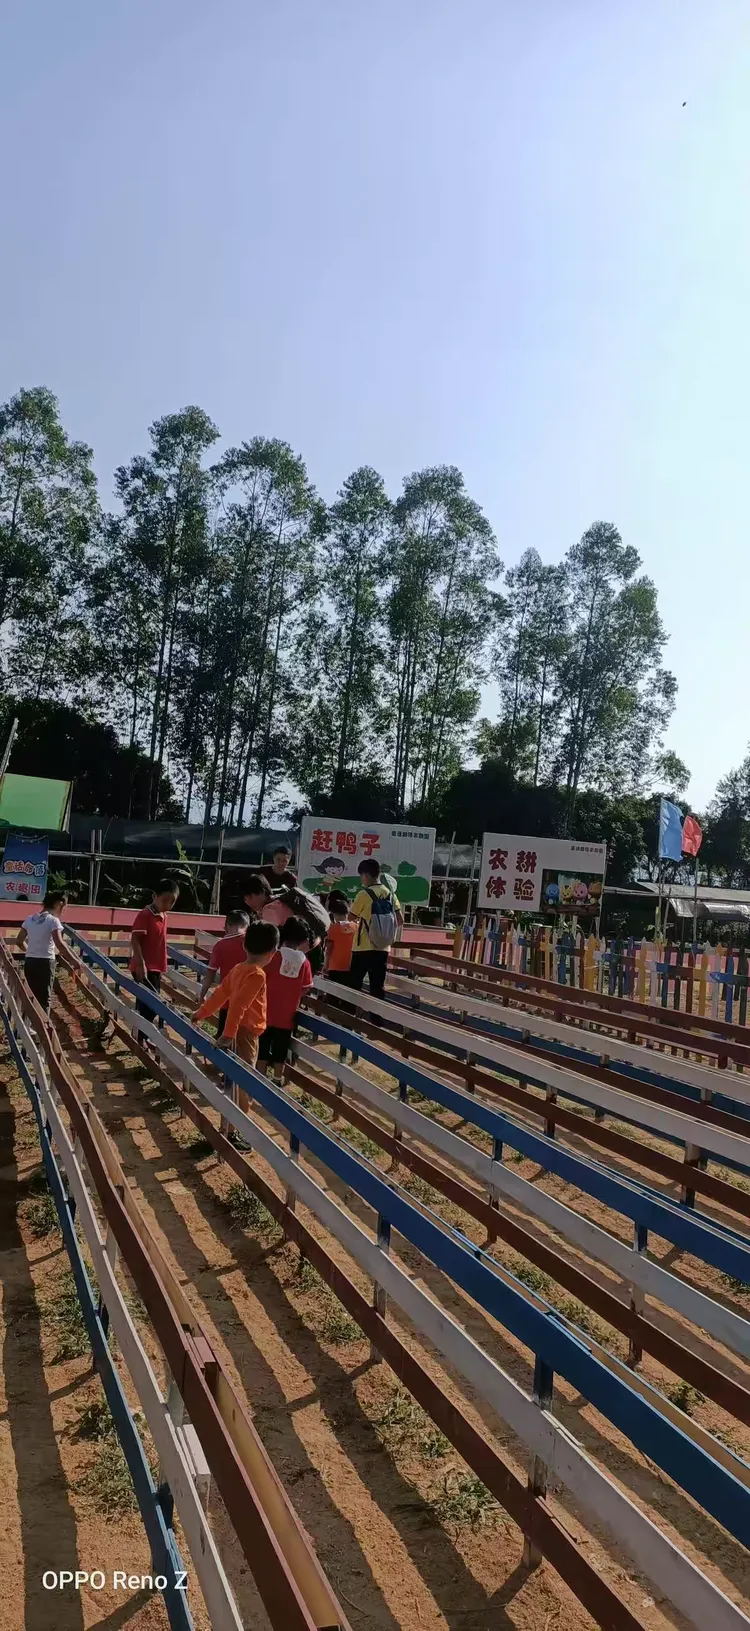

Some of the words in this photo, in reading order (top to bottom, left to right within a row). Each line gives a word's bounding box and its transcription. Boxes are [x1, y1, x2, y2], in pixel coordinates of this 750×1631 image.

[310, 828, 381, 856] 赶鸭子
[488, 848, 538, 874] 农耕
[485, 876, 535, 901] 体验
